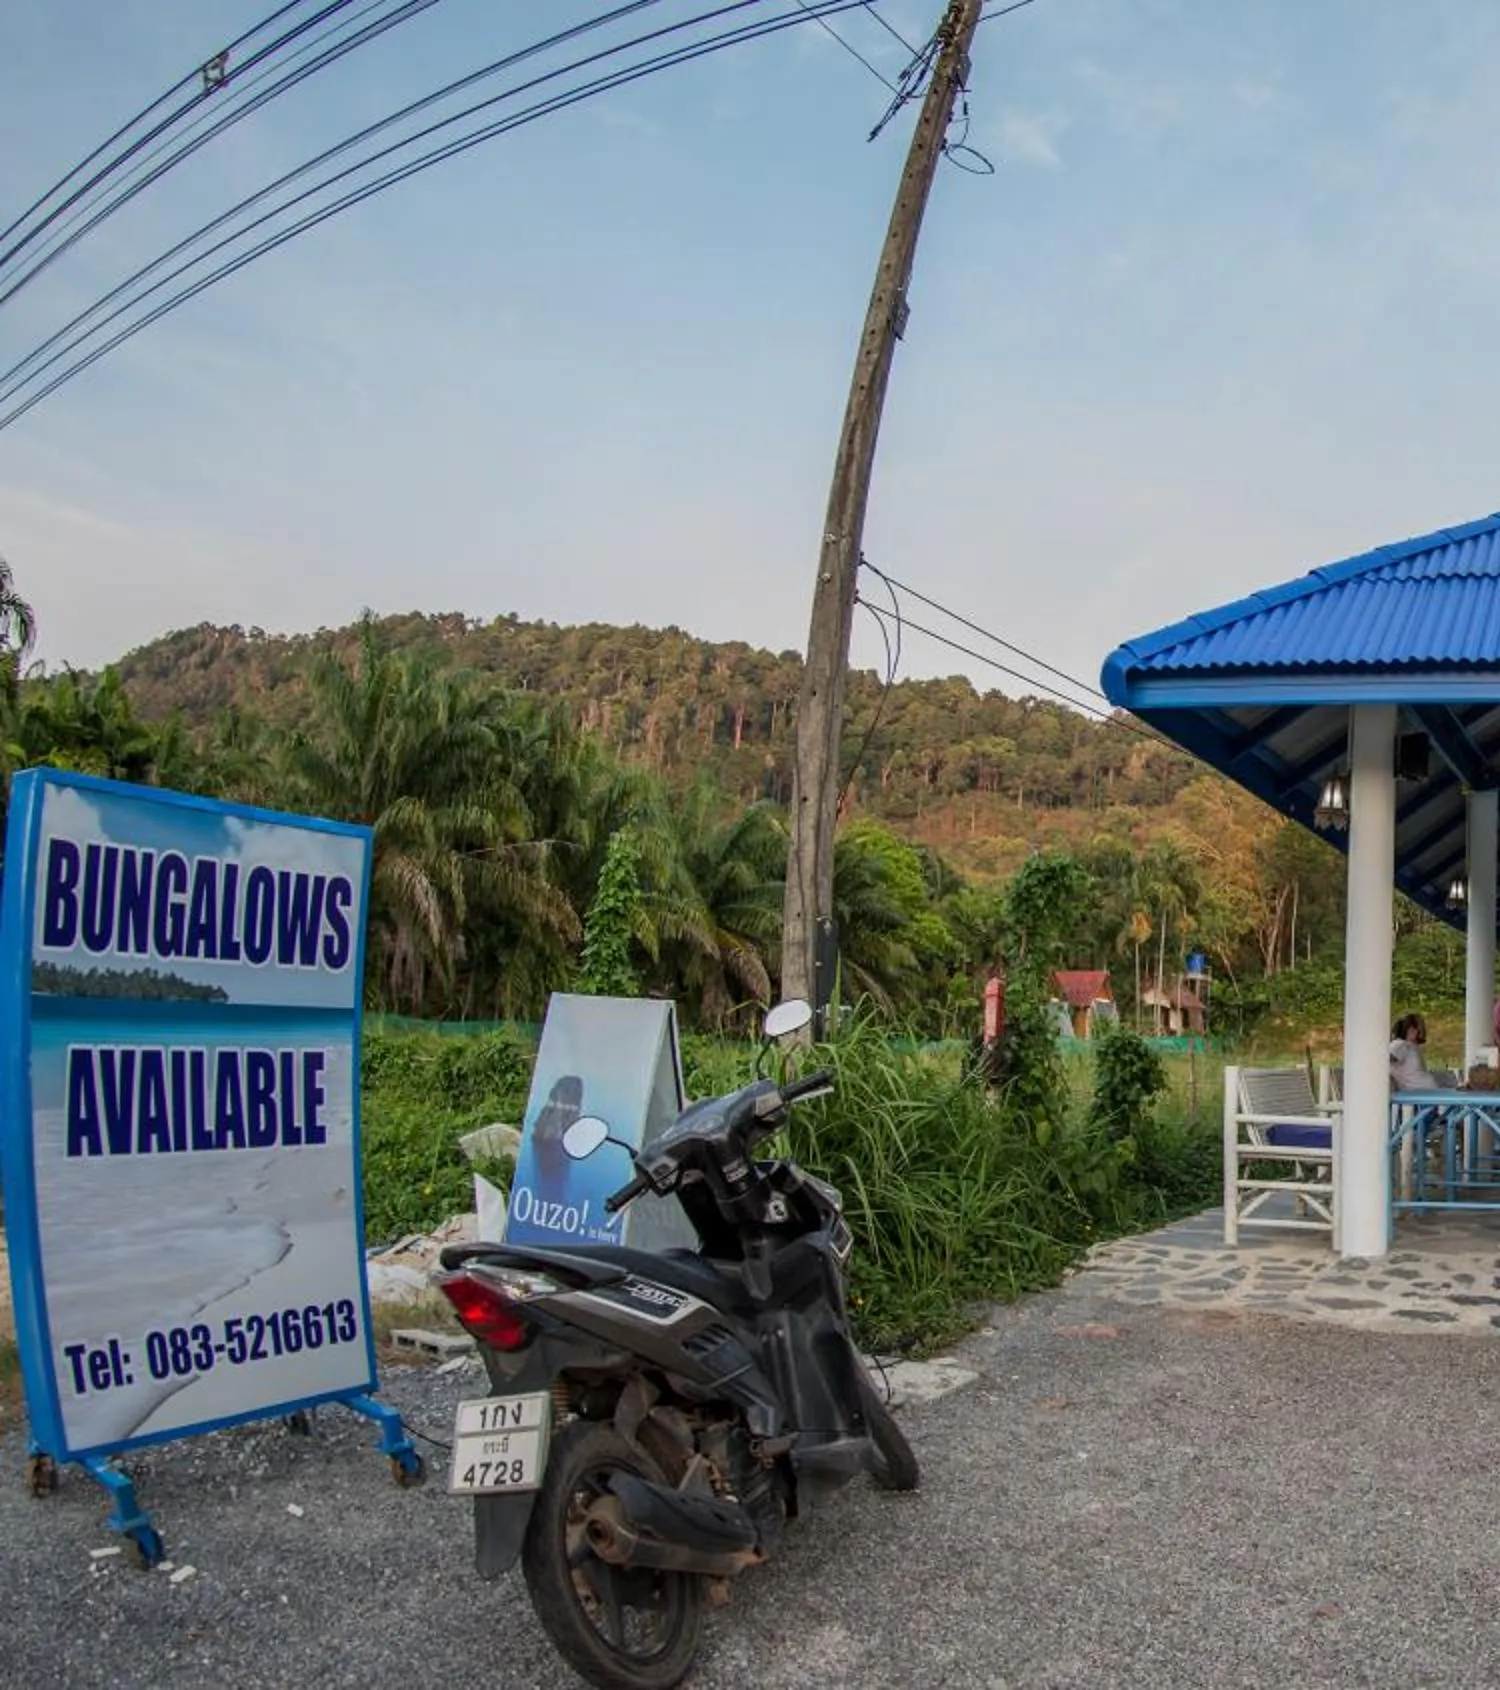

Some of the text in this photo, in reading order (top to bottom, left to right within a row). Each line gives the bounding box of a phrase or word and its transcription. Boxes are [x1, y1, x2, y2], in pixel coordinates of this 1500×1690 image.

[43, 838, 352, 971] BUNGALOWS
[65, 1047, 327, 1157] AVAILABLE
[513, 1187, 589, 1236] Ouzo!
[65, 1299, 358, 1395] Tel: 083-5216613
[463, 1459, 523, 1487] 4728
